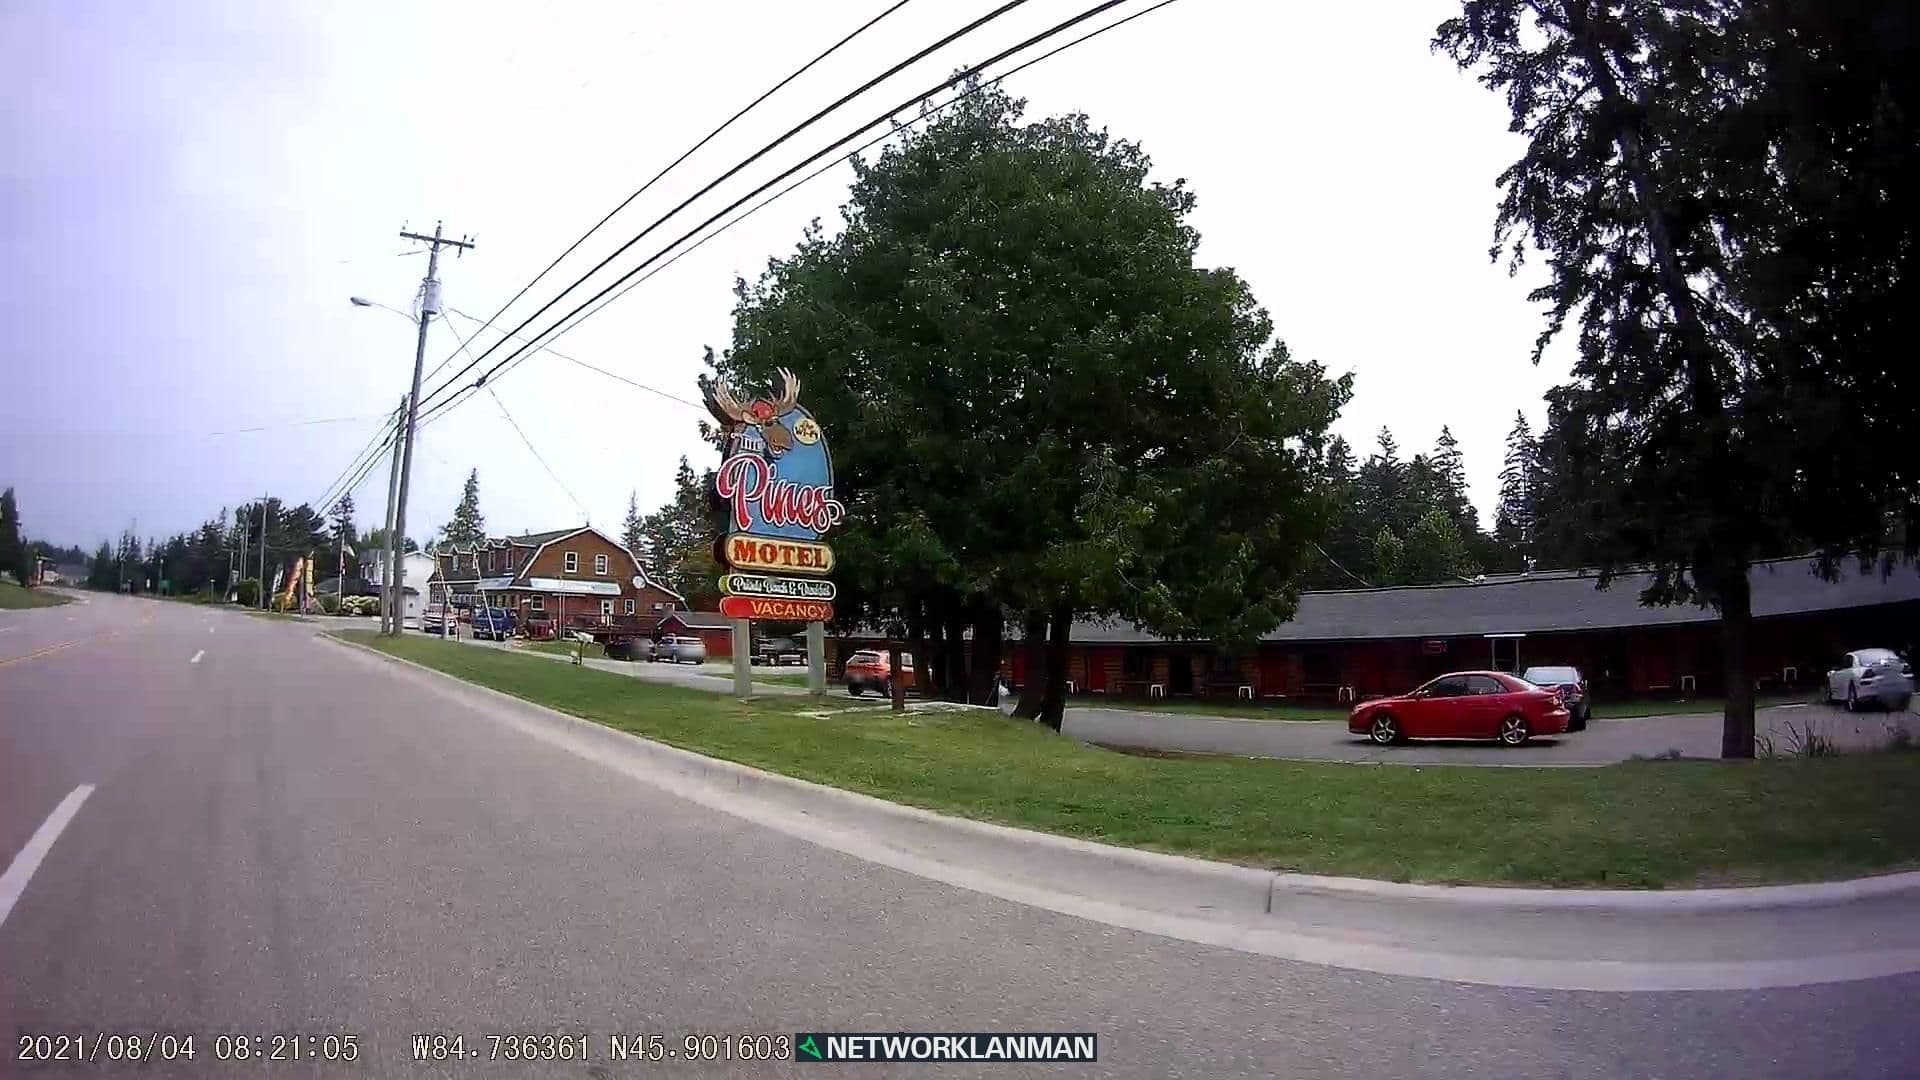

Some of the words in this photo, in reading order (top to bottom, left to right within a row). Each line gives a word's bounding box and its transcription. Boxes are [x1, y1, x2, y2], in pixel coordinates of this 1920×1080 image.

[716, 453, 846, 533] Pines
[733, 539, 829, 569] MOTEL
[750, 601, 828, 618] VACANCY
